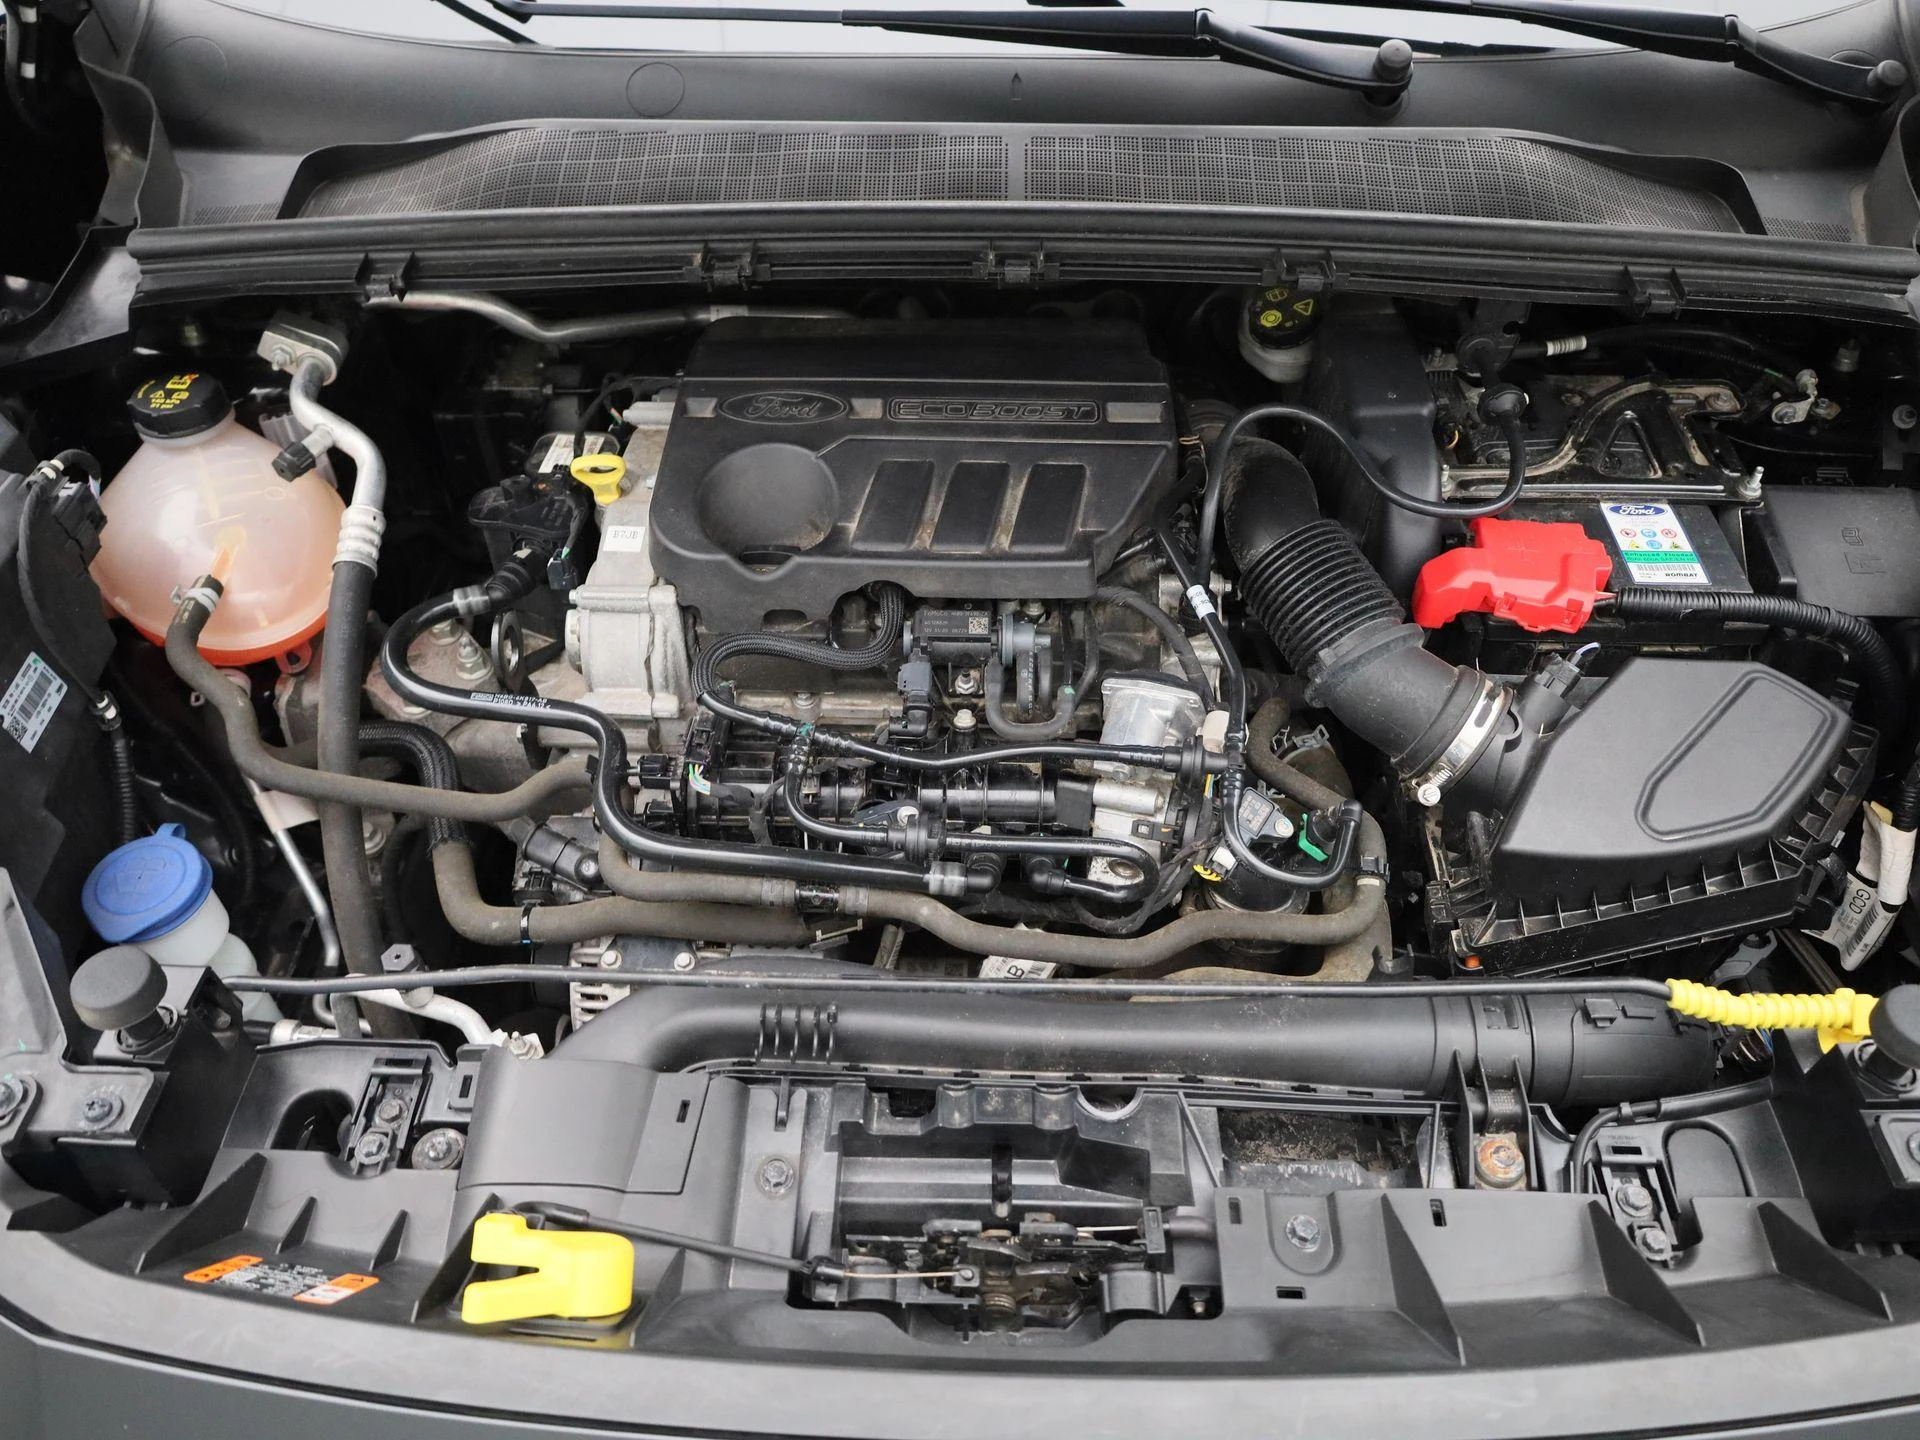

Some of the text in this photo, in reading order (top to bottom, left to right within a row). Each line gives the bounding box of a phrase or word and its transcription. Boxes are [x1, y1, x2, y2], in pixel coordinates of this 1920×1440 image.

[744, 396, 822, 418] Ford
[897, 402, 1091, 419] ECOBOOST
[1619, 505, 1655, 515] Ford
[1849, 888, 1871, 915] GCD
